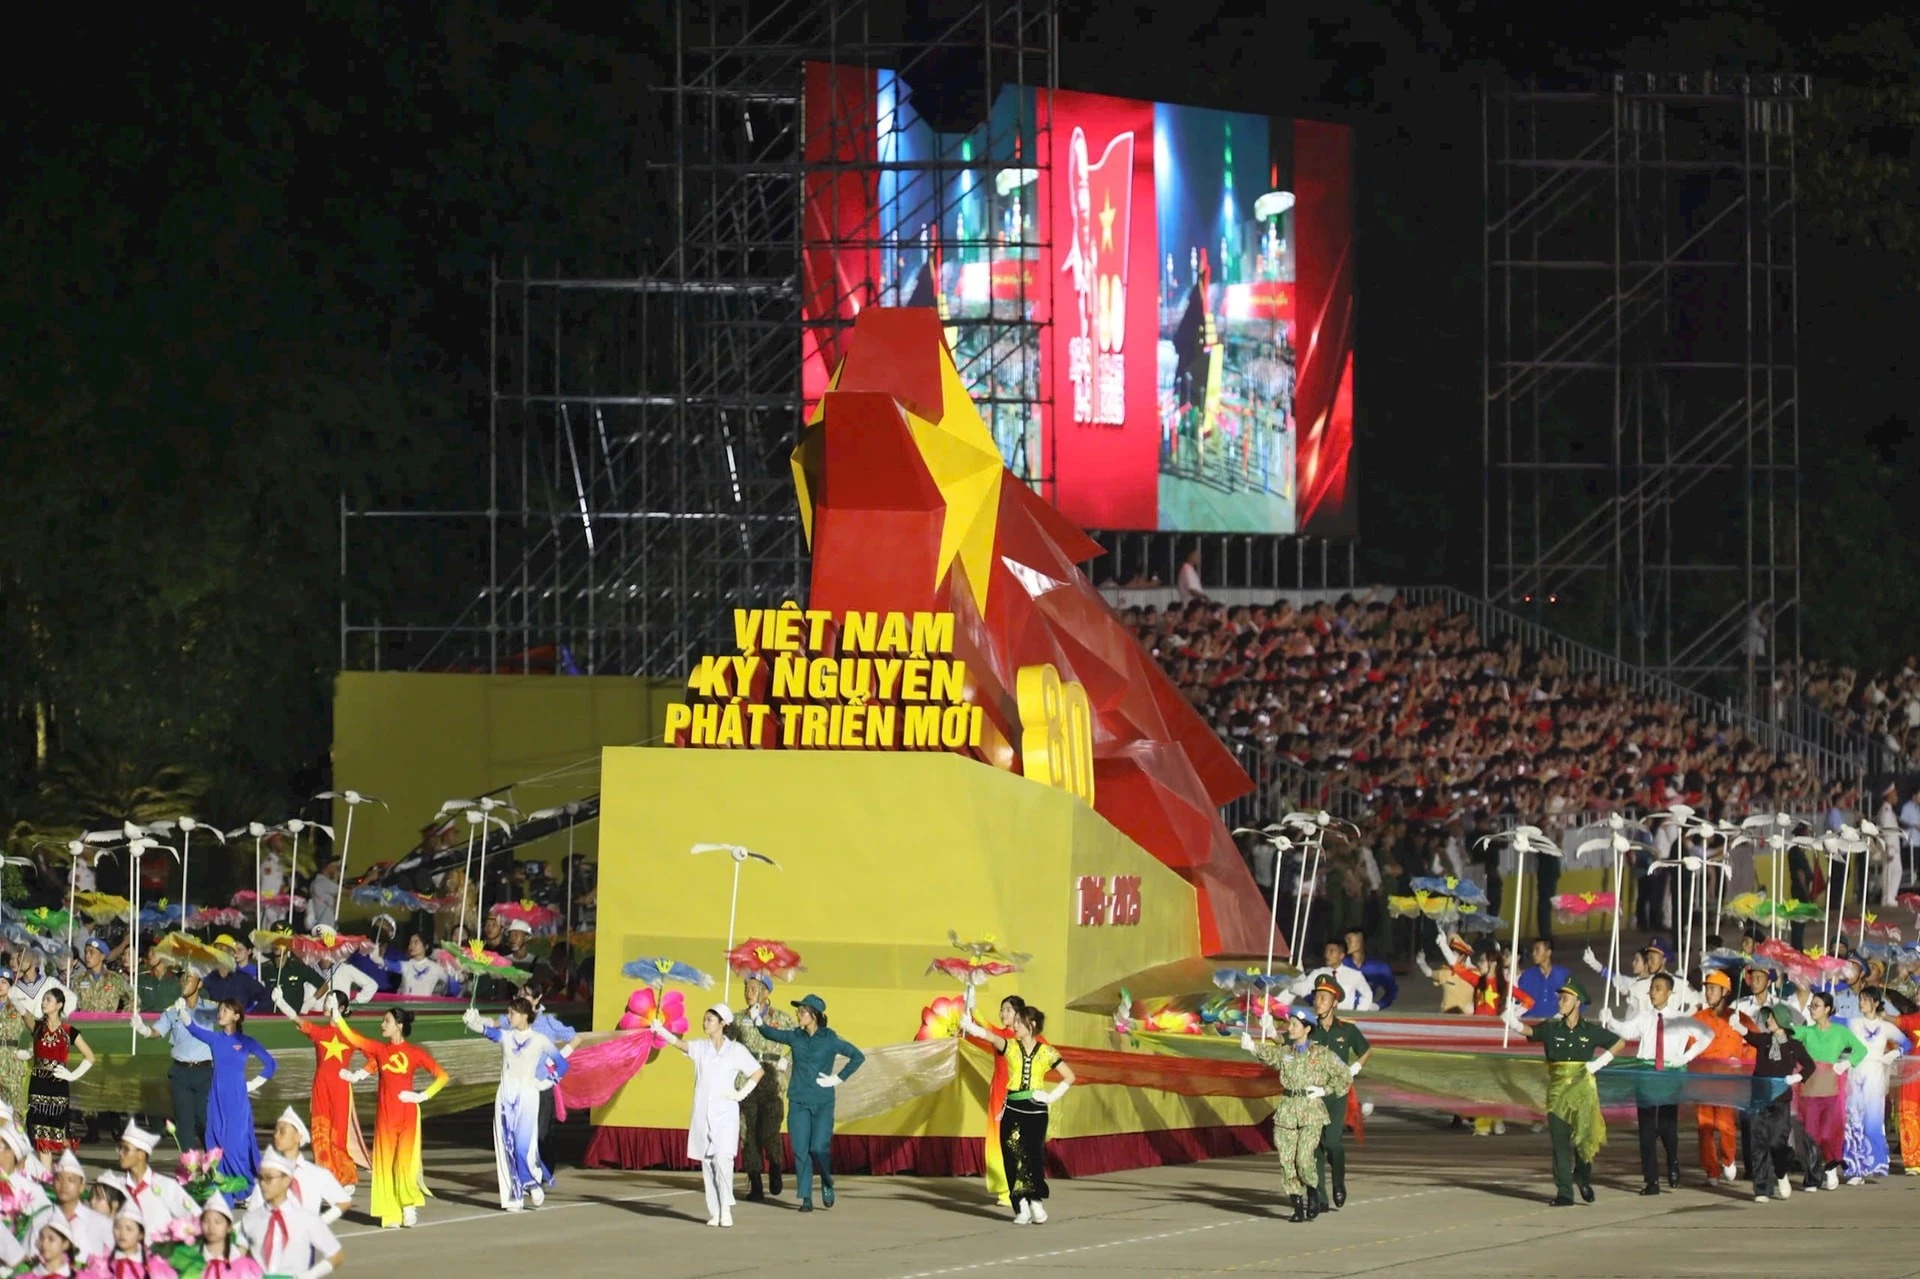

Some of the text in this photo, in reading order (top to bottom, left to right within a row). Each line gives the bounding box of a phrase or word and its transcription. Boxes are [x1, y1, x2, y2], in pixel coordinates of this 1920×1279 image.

[734, 600, 955, 656] VIỆT NAM
[699, 645, 966, 700] KỶ NGUYÊN
[664, 692, 983, 747] PHÁT TRIỂN MỚI
